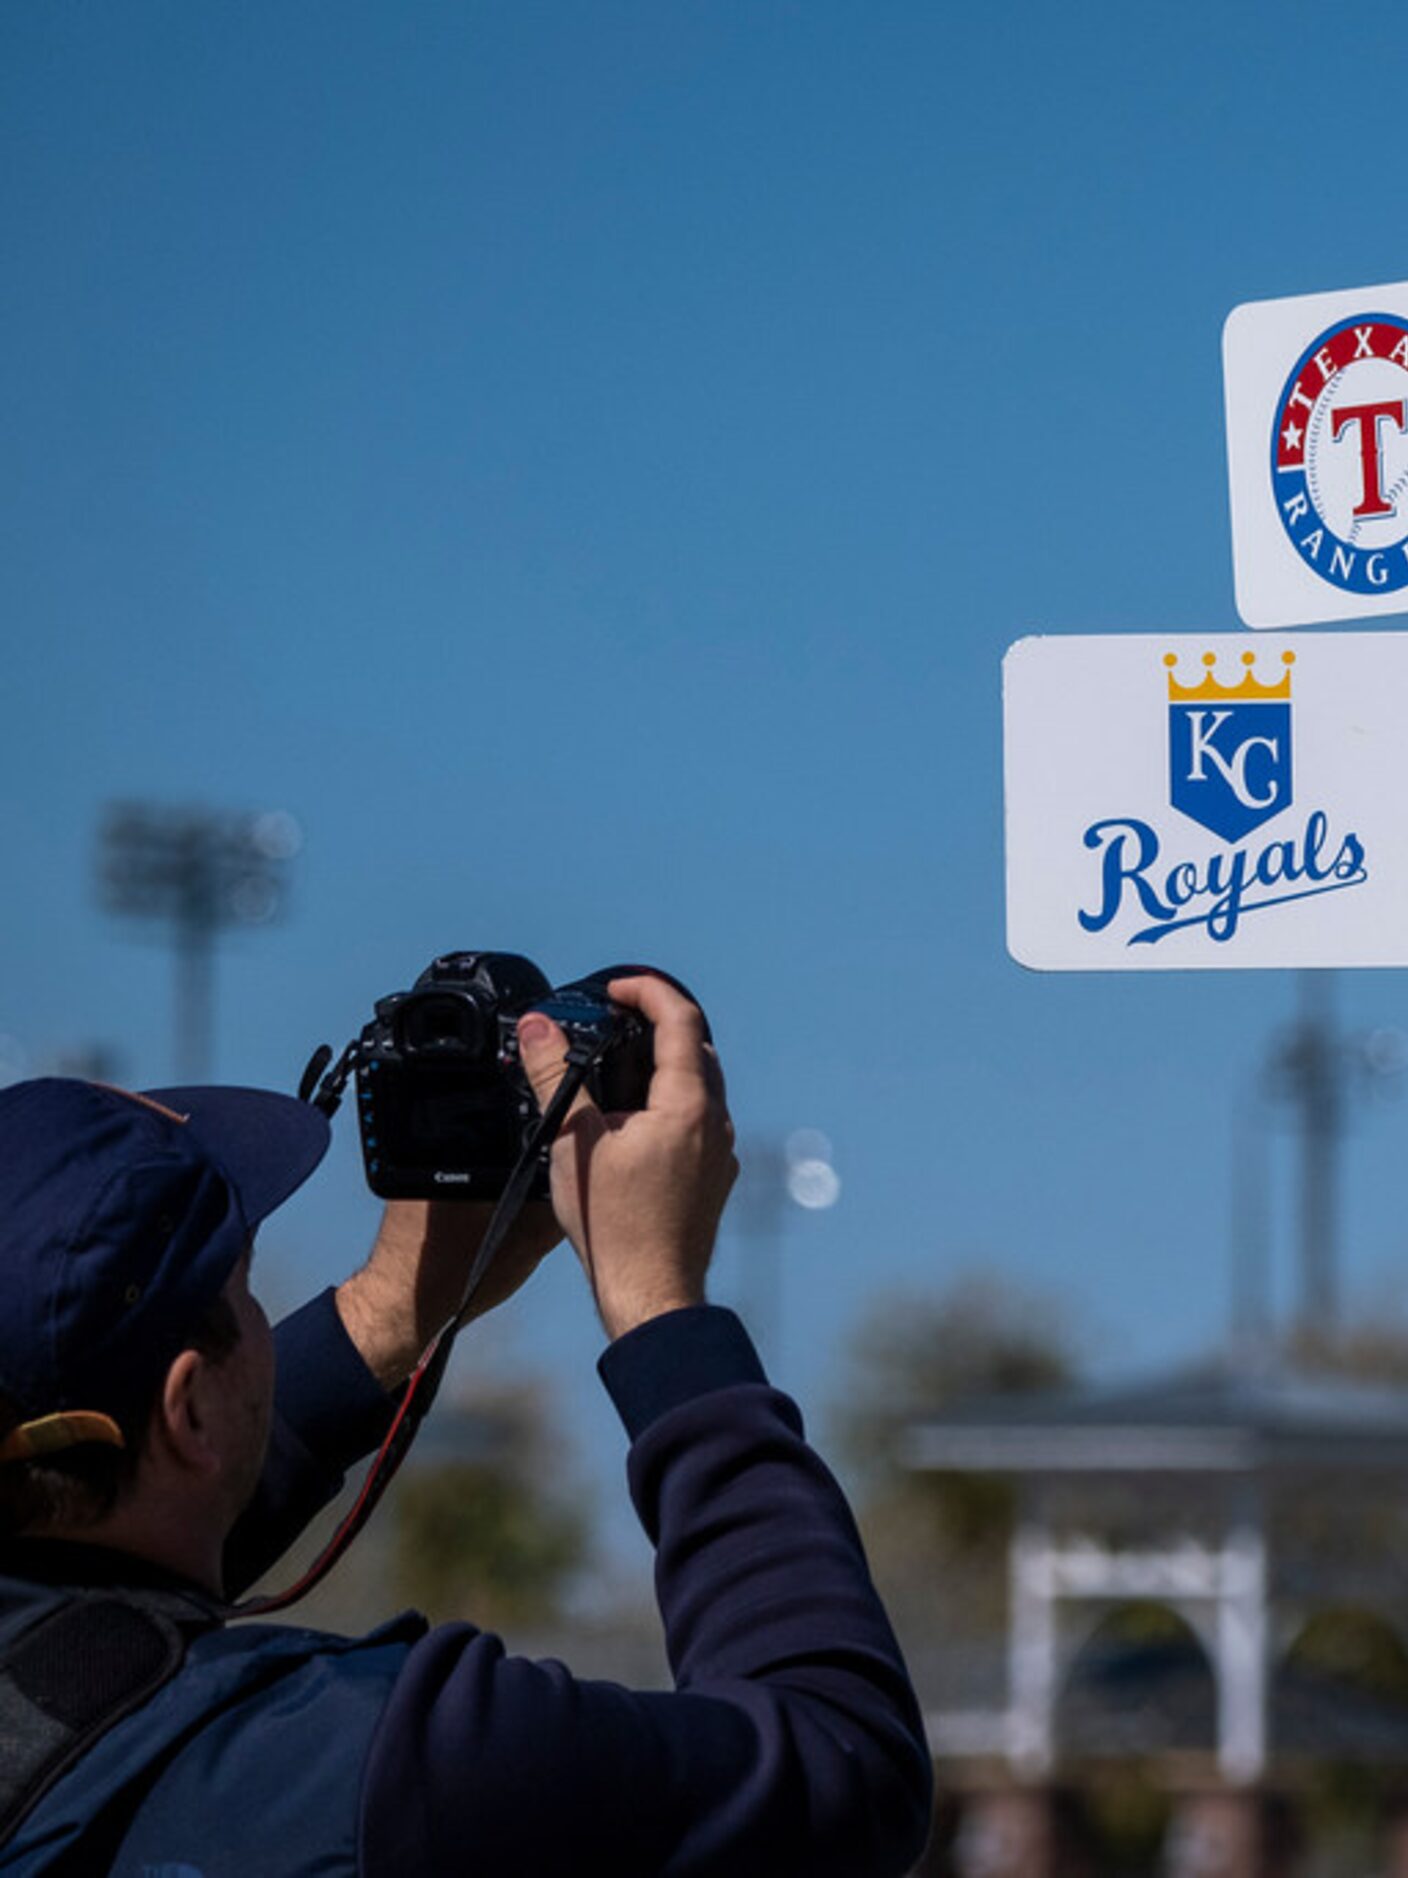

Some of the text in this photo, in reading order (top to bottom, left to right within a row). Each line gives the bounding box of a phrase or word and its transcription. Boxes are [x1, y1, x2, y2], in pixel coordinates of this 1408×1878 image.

[1330, 398, 1408, 522] T
[1184, 708, 1281, 811] KC
[1076, 810, 1368, 946] Royals
